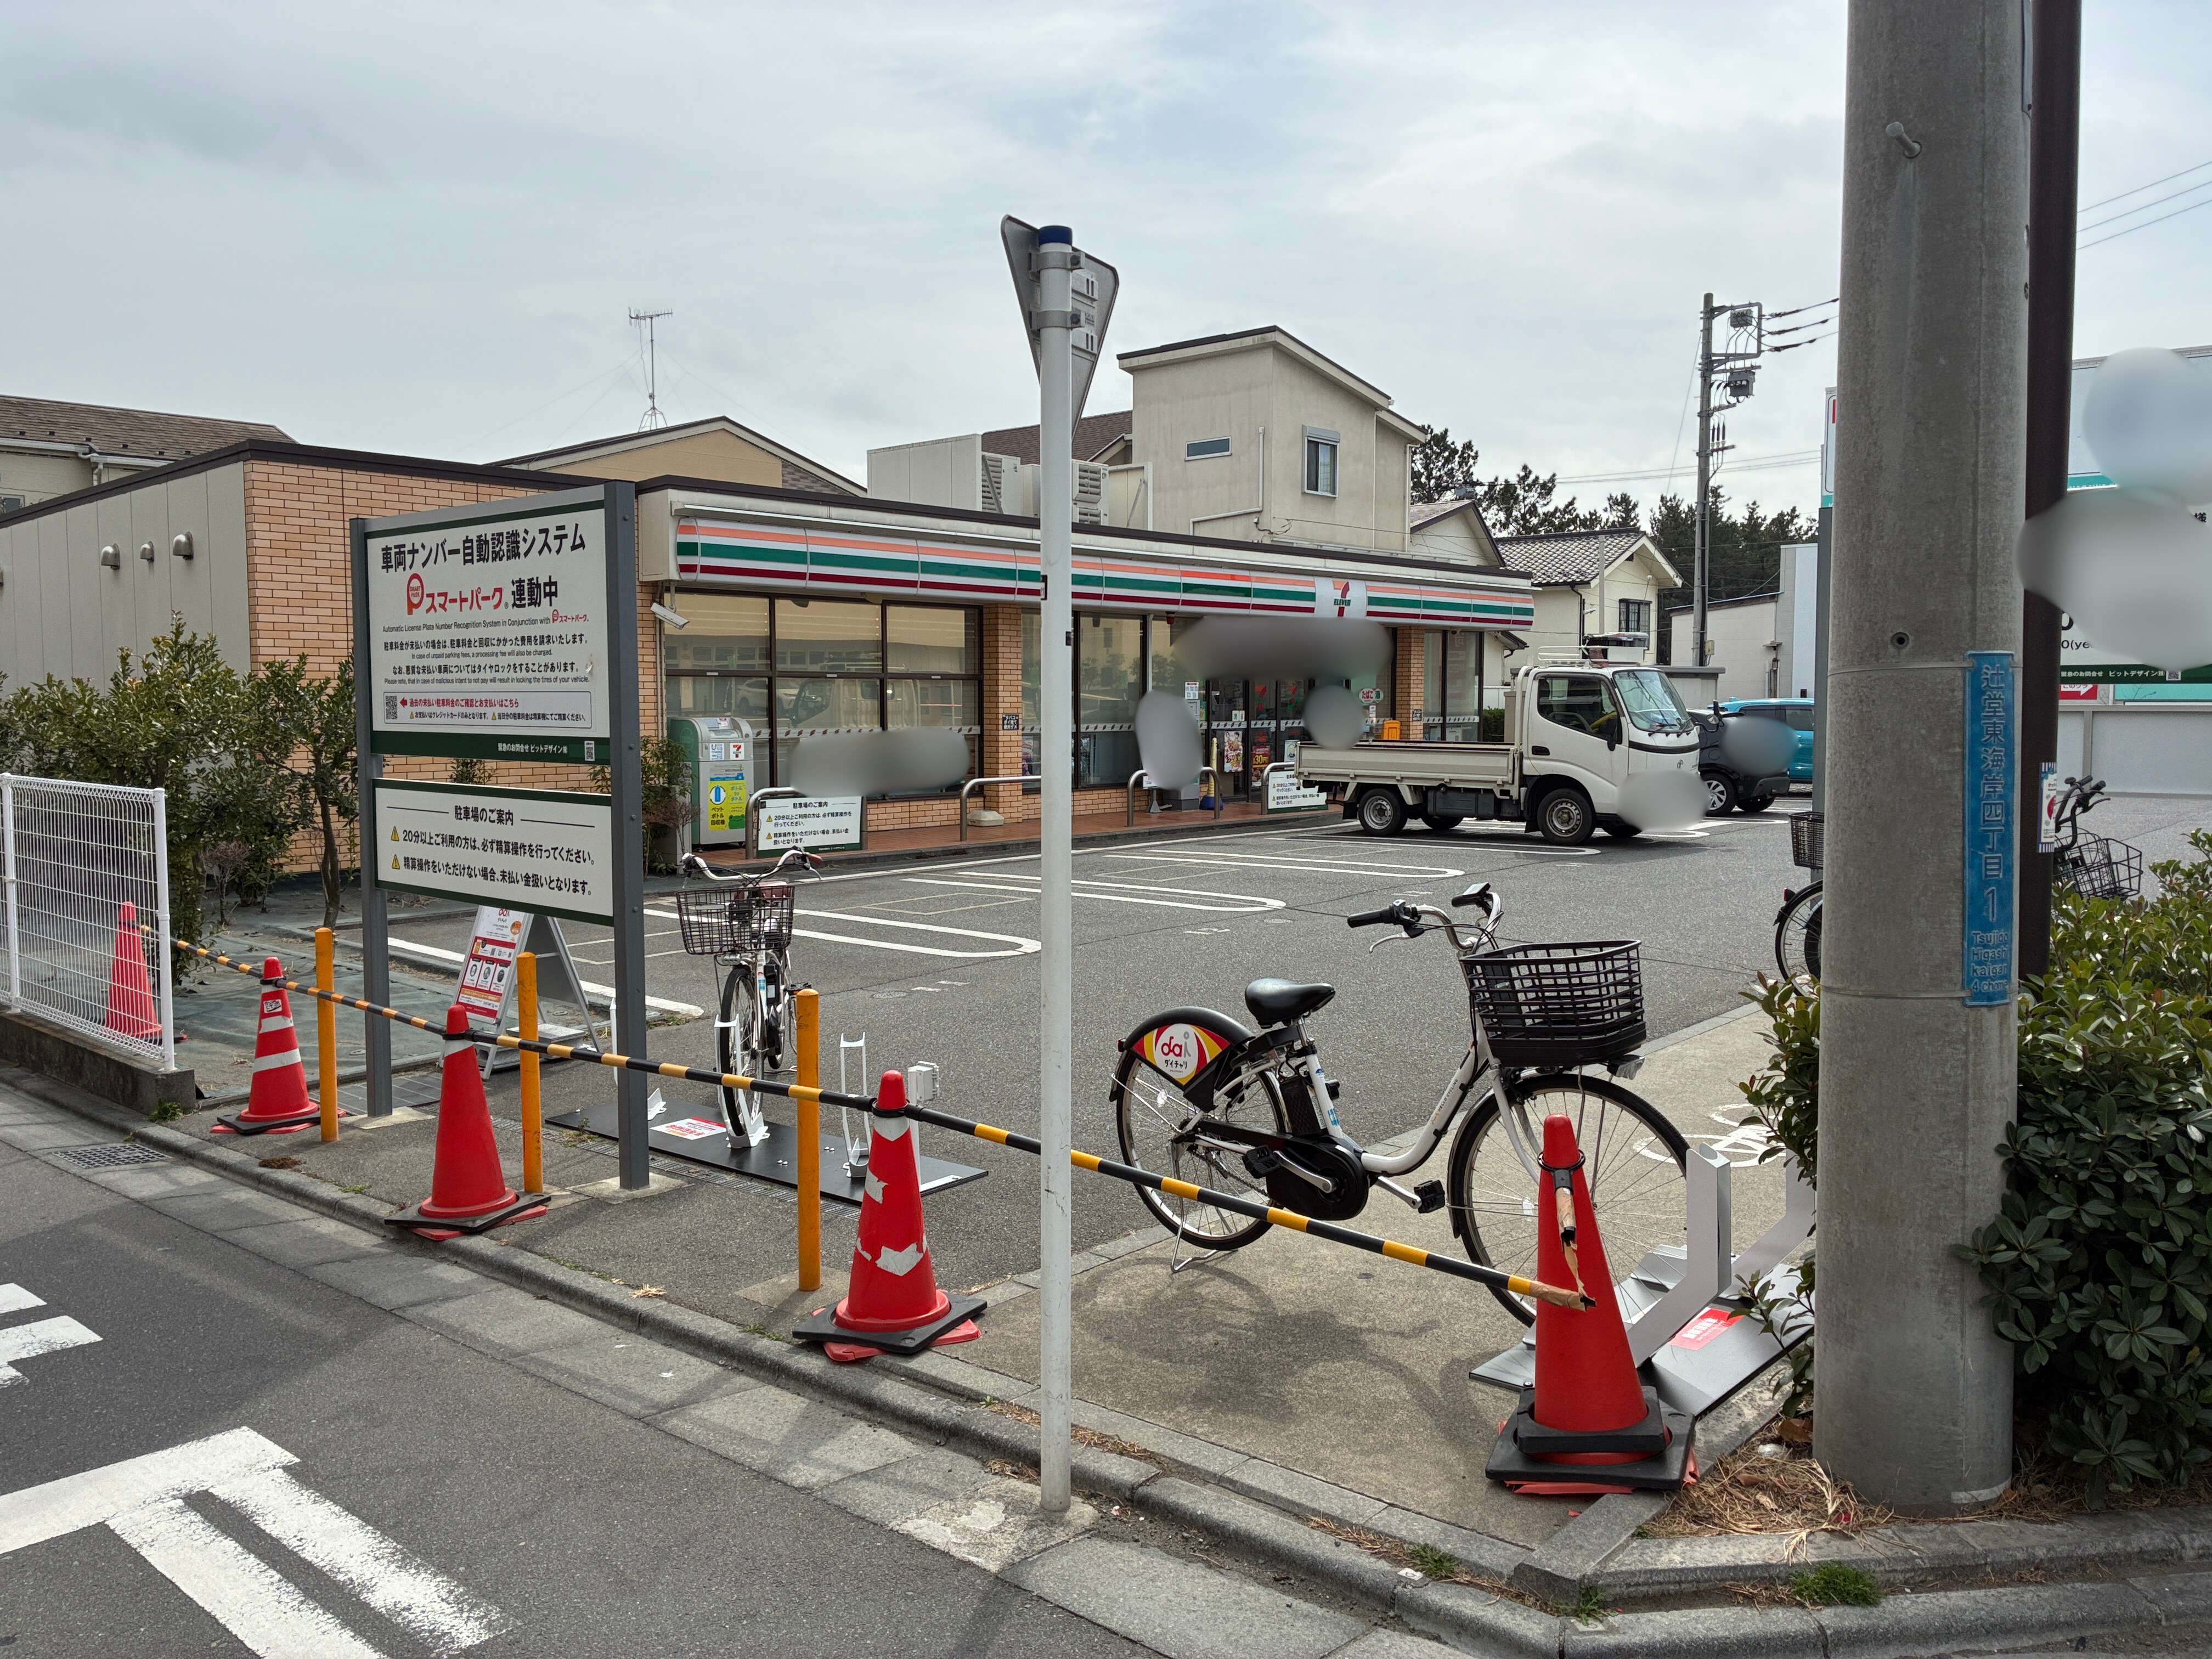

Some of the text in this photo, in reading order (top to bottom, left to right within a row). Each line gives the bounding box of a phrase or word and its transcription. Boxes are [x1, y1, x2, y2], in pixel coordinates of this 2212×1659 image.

[381, 523, 585, 573] 車両ナンバー自動認識システム
[511, 575, 558, 610] 連動中
[382, 624, 404, 633] Automatic
[404, 624, 422, 632] License
[422, 623, 435, 631] Plate
[435, 622, 453, 630] Number
[454, 620, 482, 630] Recognition
[483, 618, 501, 628] System
[501, 618, 506, 627] in
[507, 617, 538, 627] Conjunction
[539, 616, 551, 624] with
[409, 697, 519, 708] 過去の未払い駐車料金のご確認とお支払いはこちら
[1362, 690, 1374, 699] たばこ
[454, 805, 514, 826] 駐車場のご案内
[402, 829, 595, 865] 20分以上ご利用の方は、必ず精算操作を行ってください。
[403, 856, 592, 896] 精算操作をいただけない場合、未払い金扱いとなります。
[1164, 1059, 1188, 1069] ダイチャリ
